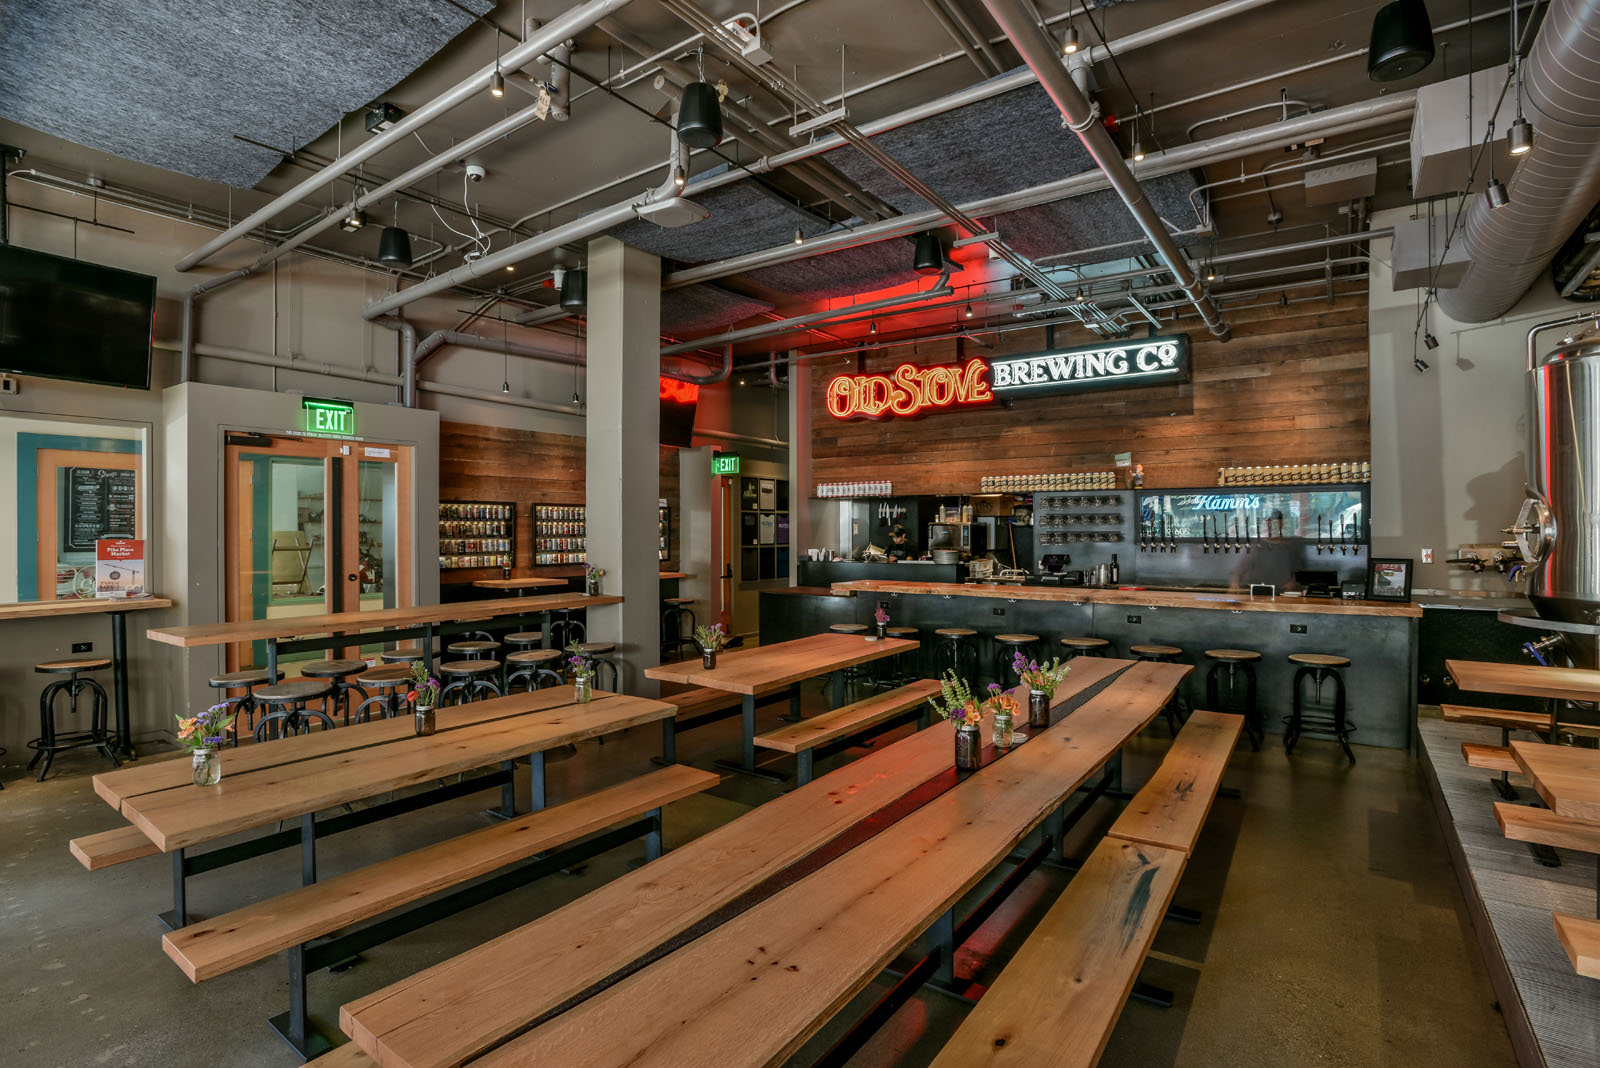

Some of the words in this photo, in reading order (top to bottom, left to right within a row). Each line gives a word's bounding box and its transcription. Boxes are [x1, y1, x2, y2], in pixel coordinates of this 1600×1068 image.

[994, 350, 1128, 386] BREWING
[826, 375, 894, 417] OLD
[889, 359, 993, 415] STOVE
[316, 408, 347, 431] EXIT
[720, 458, 735, 471] EXIT
[1192, 495, 1260, 511] Hamm's
